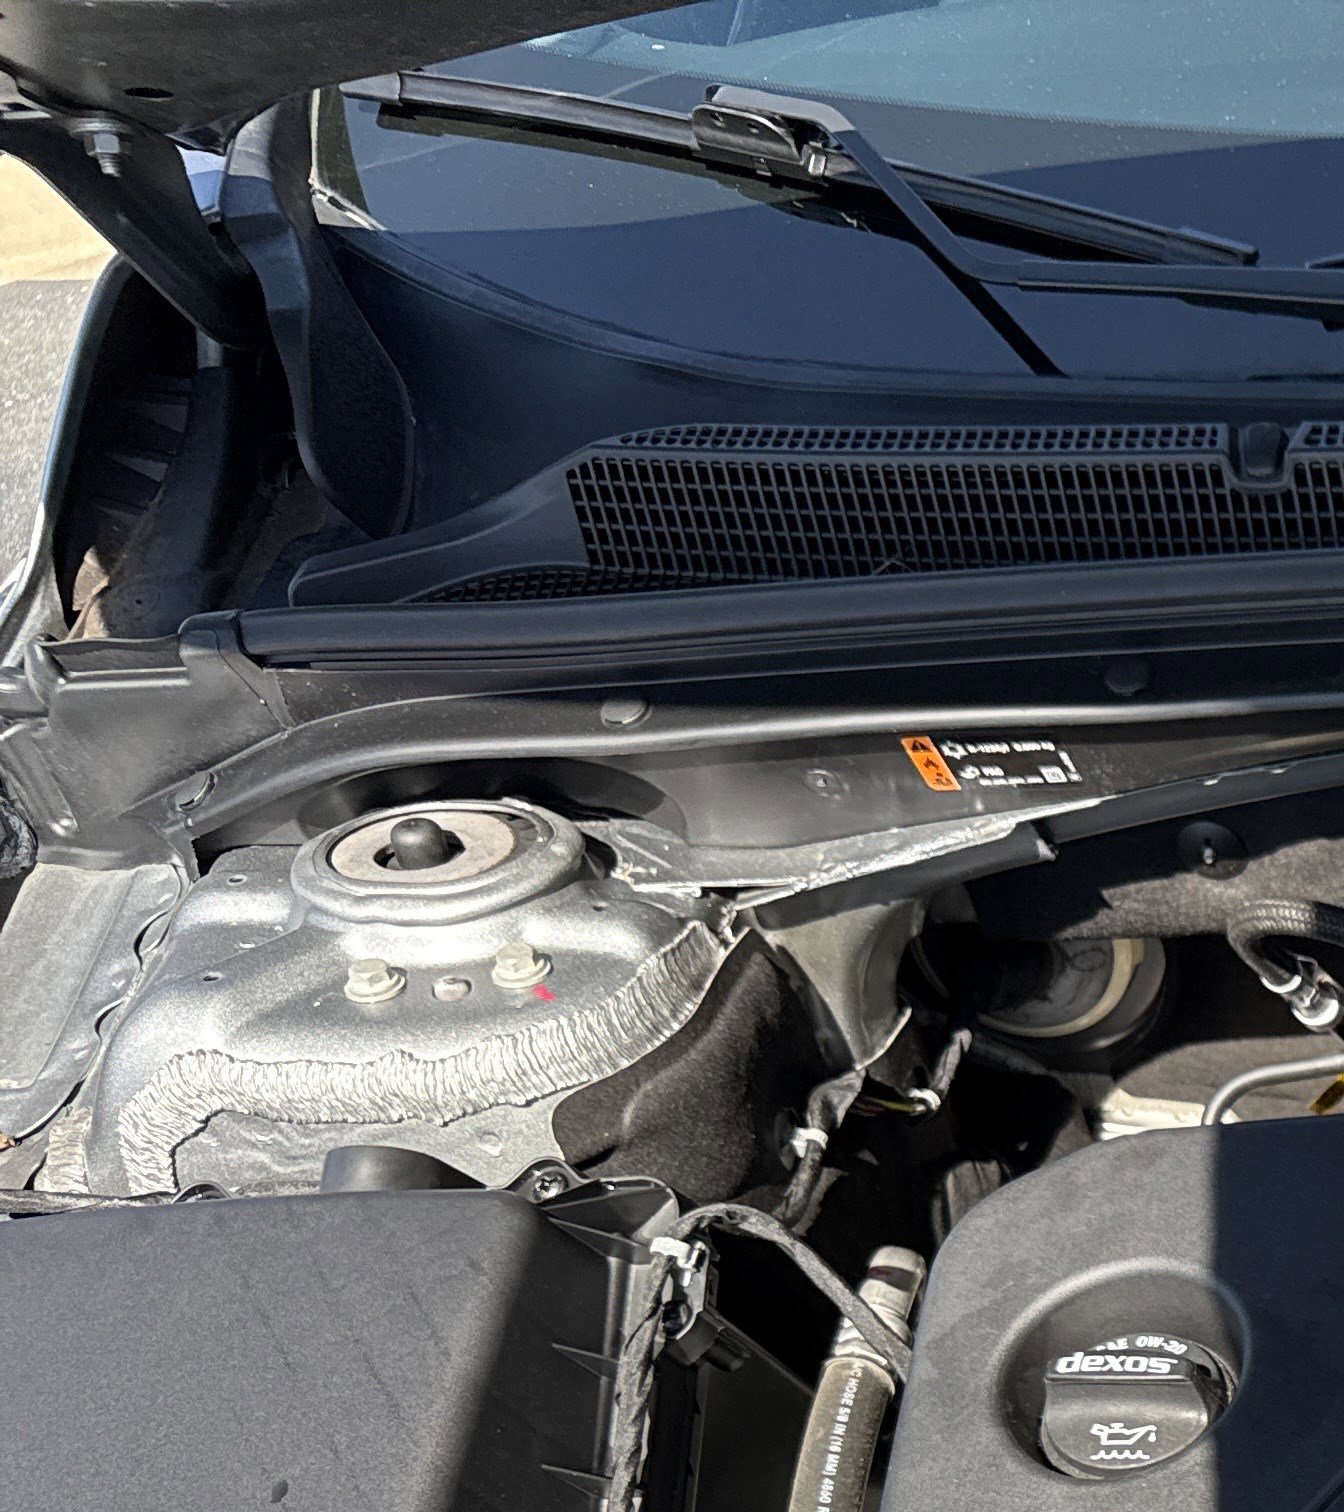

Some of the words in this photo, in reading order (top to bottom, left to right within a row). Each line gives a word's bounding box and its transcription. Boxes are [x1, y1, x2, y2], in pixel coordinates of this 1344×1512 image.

[1135, 1335, 1188, 1355] 0W-20
[1056, 1351, 1179, 1375] dexos
[840, 1377, 860, 1406] HOSE
